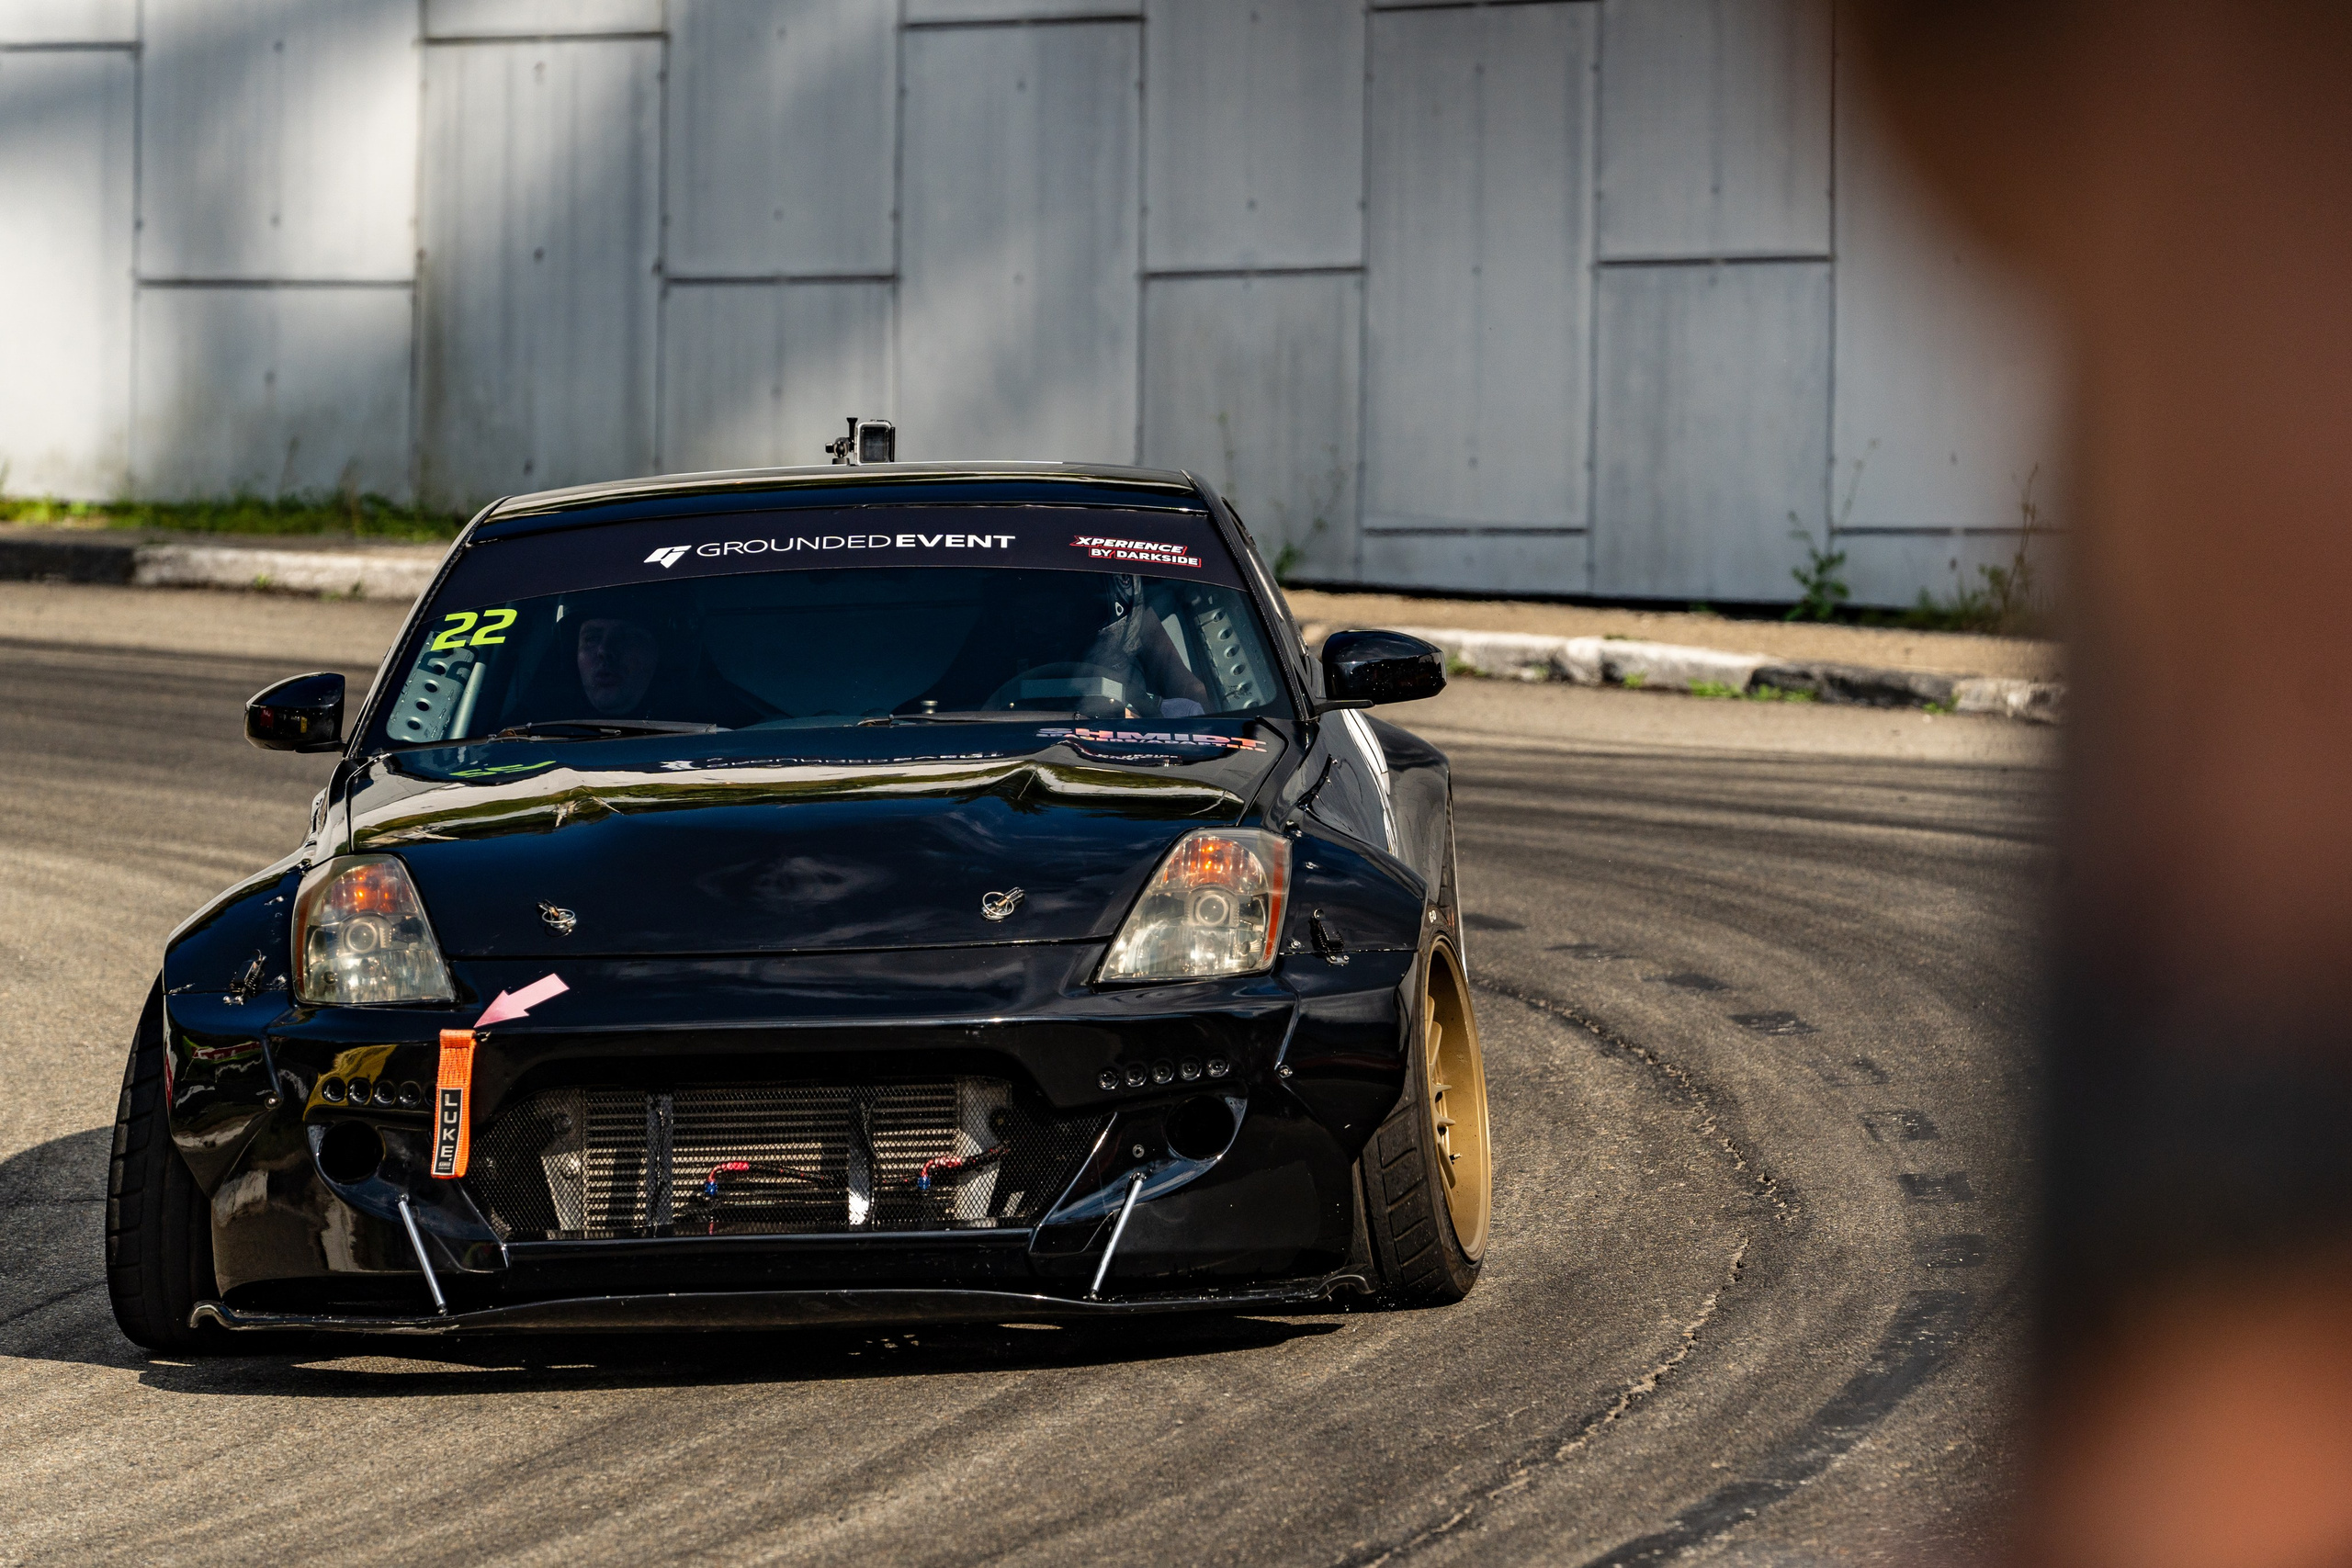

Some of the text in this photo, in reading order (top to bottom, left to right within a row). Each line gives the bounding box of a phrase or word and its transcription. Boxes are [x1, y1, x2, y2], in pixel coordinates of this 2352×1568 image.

[1076, 536, 1185, 554] XPERIENCE
[1091, 548, 1198, 566] BY DARKSIDE
[430, 608, 518, 651] 22
[1038, 728, 1267, 748] SHMIDT
